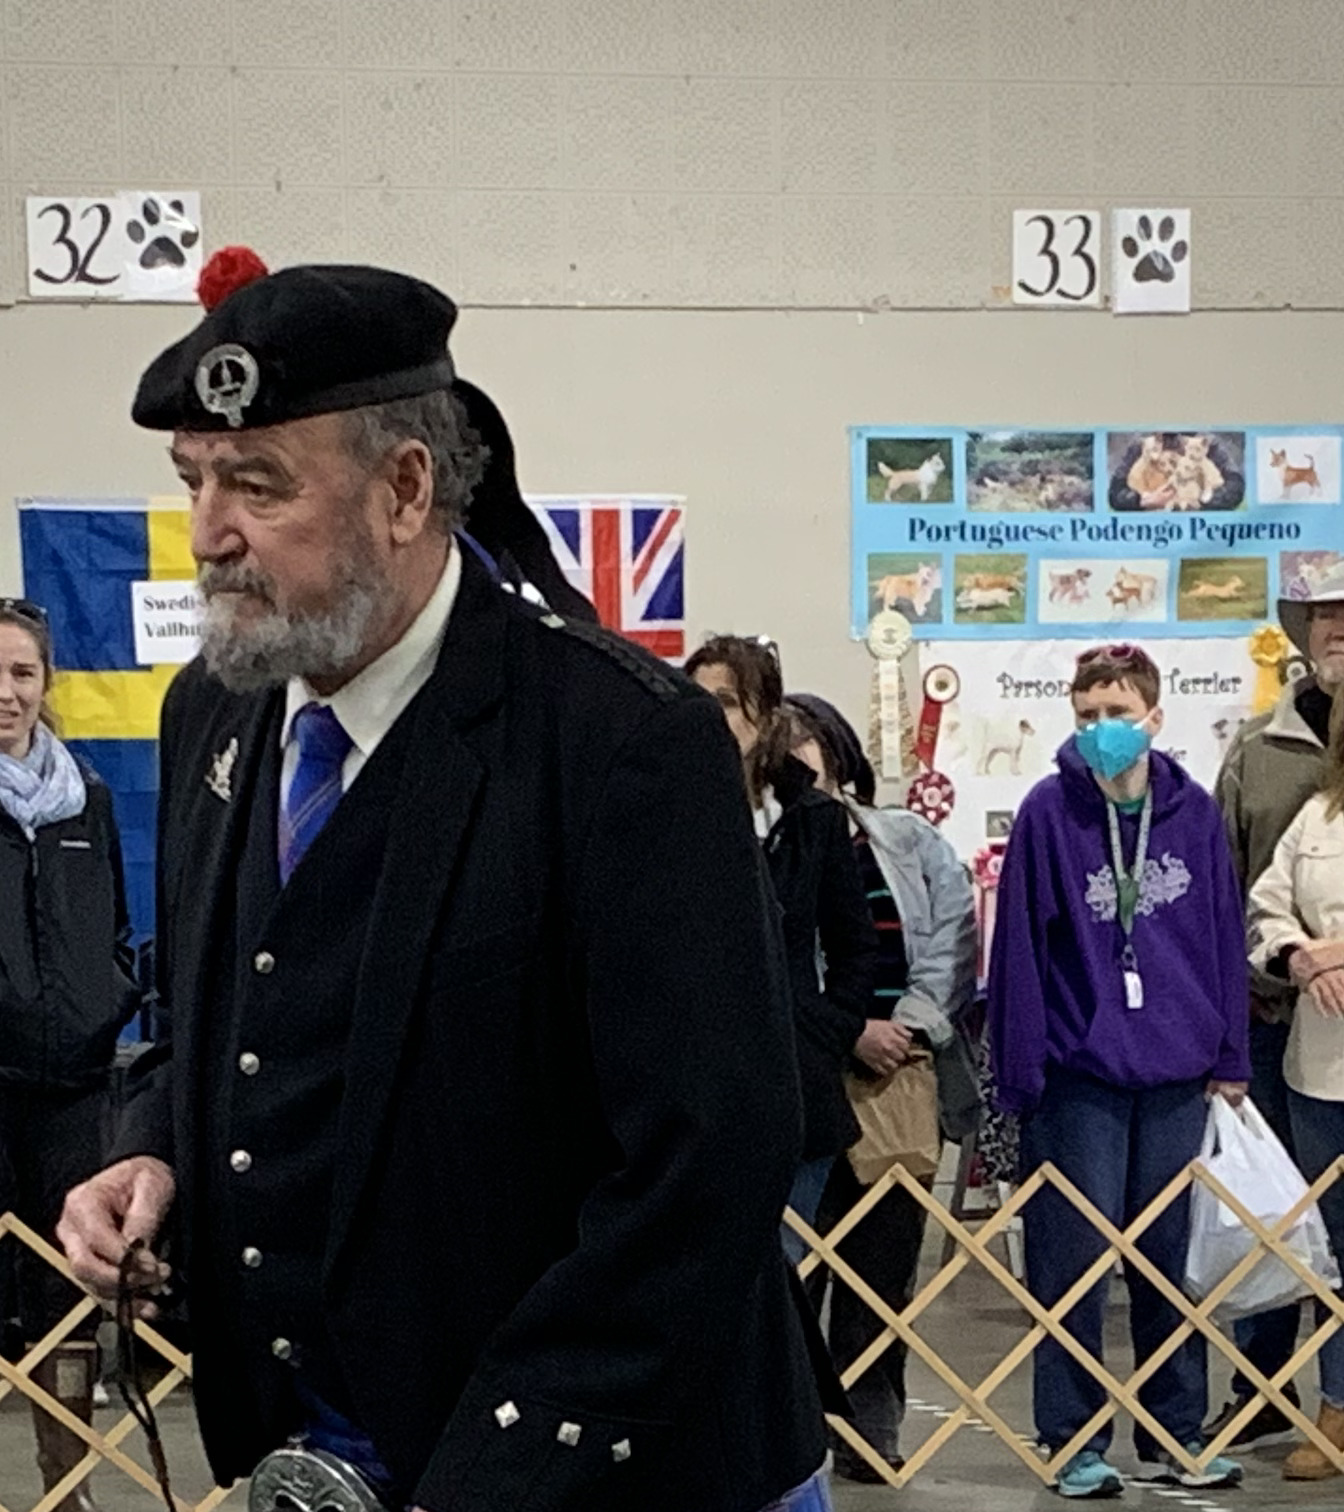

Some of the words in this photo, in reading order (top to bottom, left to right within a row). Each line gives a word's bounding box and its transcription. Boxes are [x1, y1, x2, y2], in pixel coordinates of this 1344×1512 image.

[34, 203, 121, 286] 32
[1018, 214, 1098, 301] 33
[909, 517, 1063, 549] Portuguese
[1070, 516, 1183, 549] Podengo
[1190, 518, 1301, 548] Pequeno
[143, 595, 197, 612] Swedi
[144, 621, 203, 638] Vallhu
